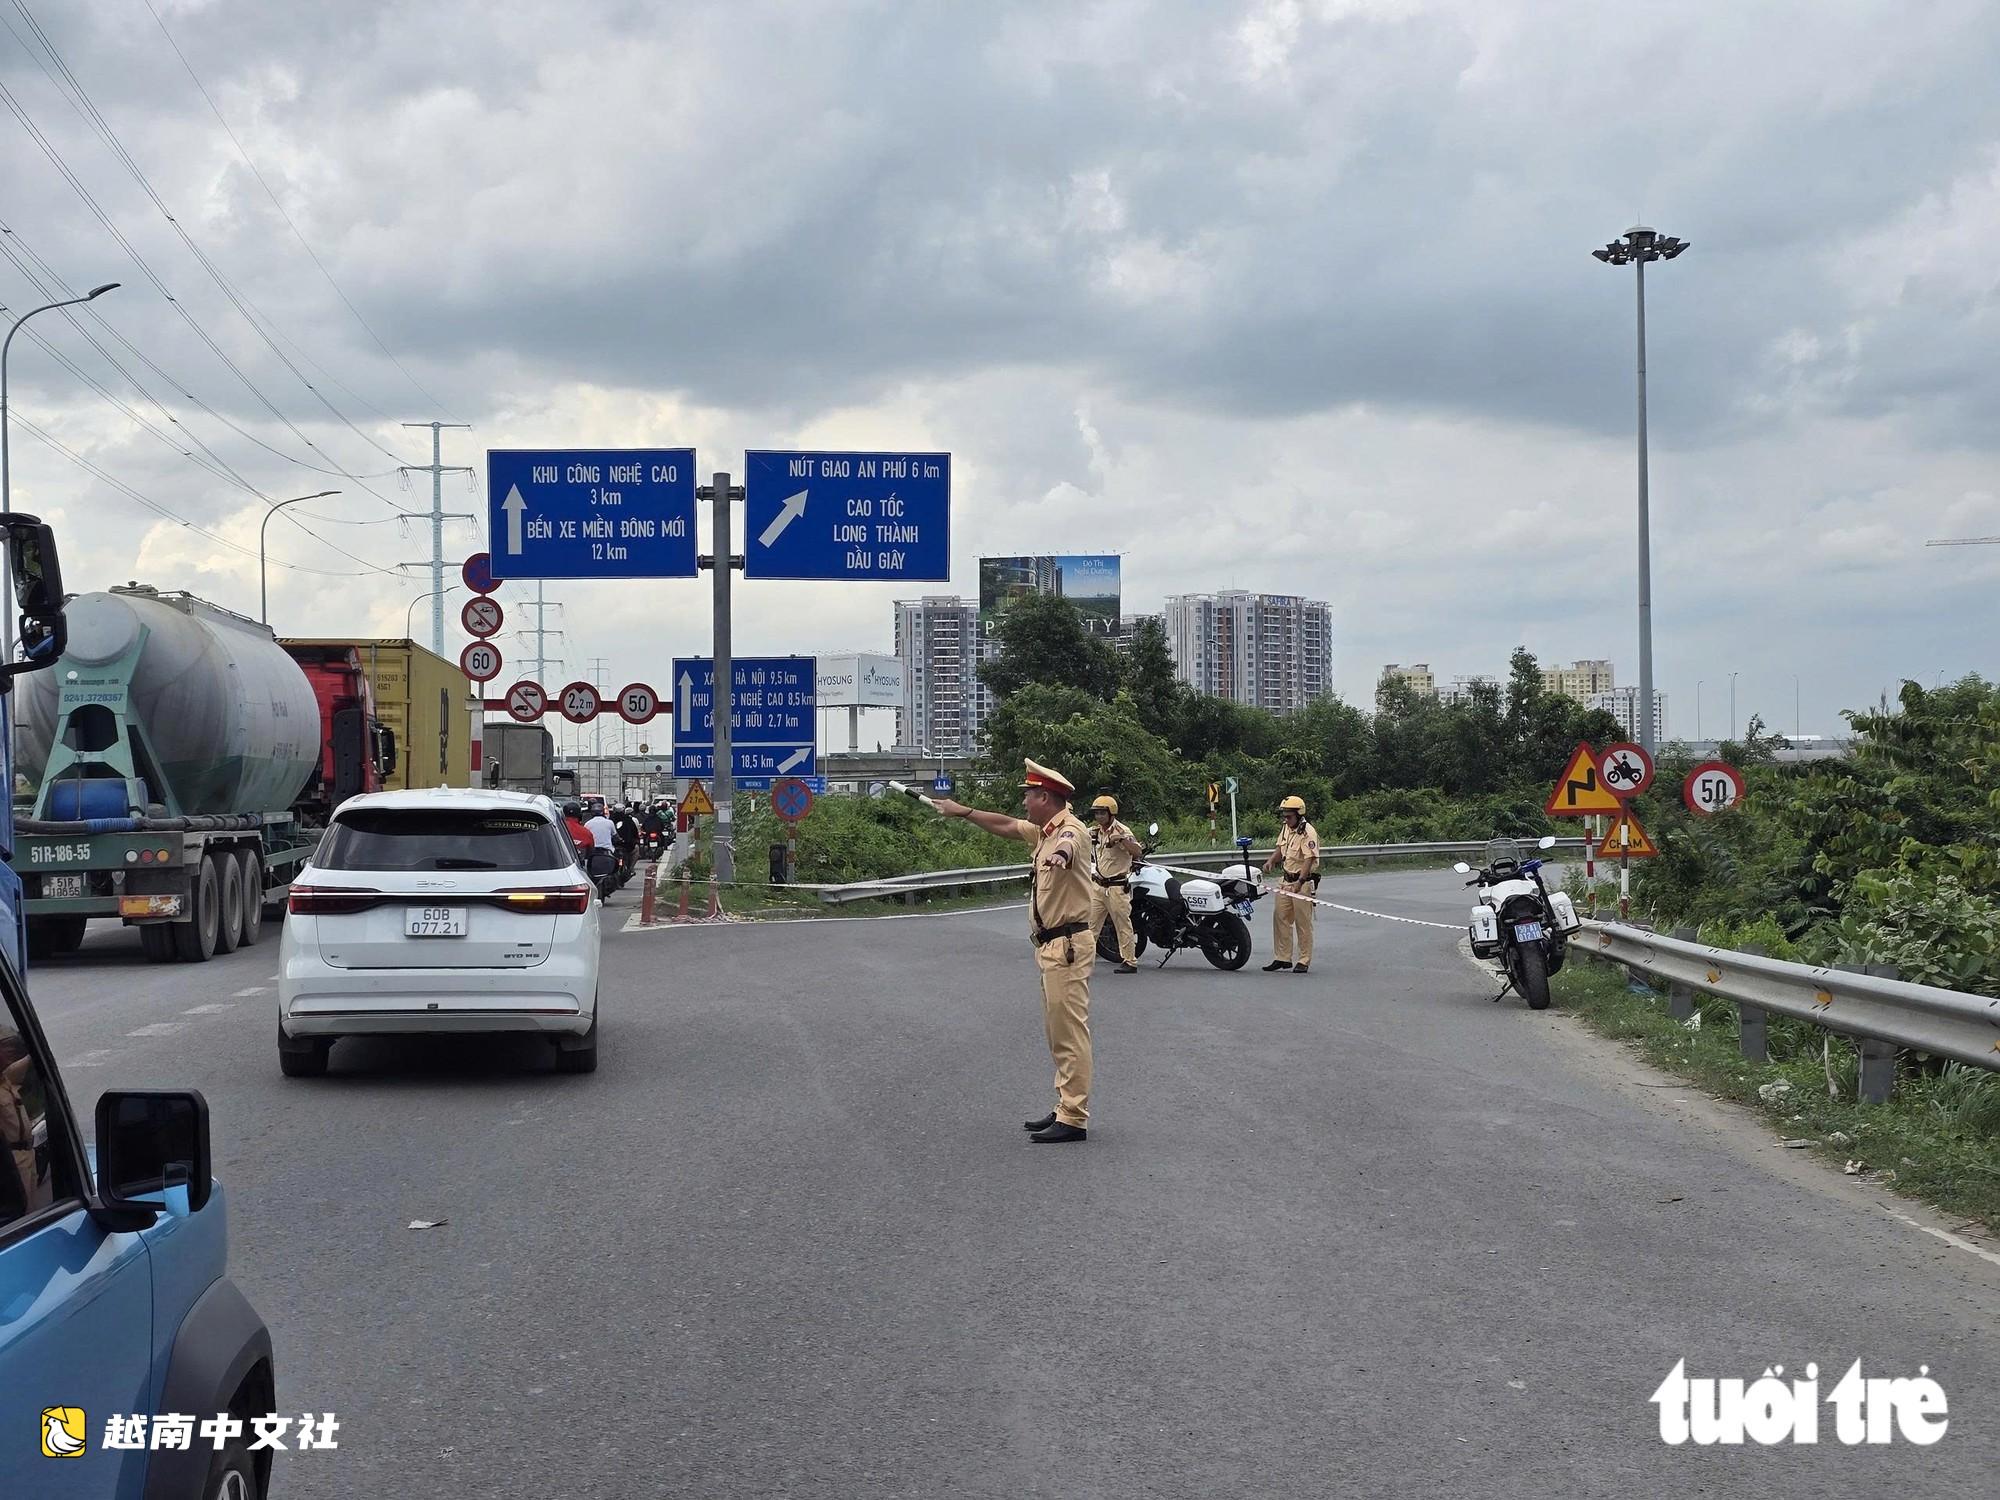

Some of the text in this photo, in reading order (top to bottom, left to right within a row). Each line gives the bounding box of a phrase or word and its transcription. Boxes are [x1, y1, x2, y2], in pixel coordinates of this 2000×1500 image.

[533, 463, 677, 485] KHU CÔNG NGHỆ CAO
[789, 456, 940, 479] NÚT GIAO AN PHÚ 6 km
[590, 488, 622, 505] 3 km
[847, 492, 904, 517] CAO TỐC
[527, 513, 685, 539] BẾN XE MIỀN ĐÔNG MỚI
[834, 521, 919, 543] LONG THÀNH
[592, 543, 627, 560] 12 km
[847, 545, 906, 570] DẦU GIÂY
[472, 652, 490, 669] 60
[735, 668, 747, 685] HÀ
[751, 668, 765, 687] NỘI
[770, 671, 783, 685] 9,5
[785, 671, 797, 685] km
[817, 674, 853, 687] HYOSUNG
[874, 676, 900, 687] HYOSUNG
[628, 695, 647, 712] 50
[692, 694, 709, 707] KHU
[740, 691, 762, 709] NGHỆ
[767, 692, 784, 706] CAO
[788, 692, 800, 707] 8,5
[801, 692, 814, 706] km
[745, 711, 762, 728] HỮU
[768, 714, 782, 728] 2,7
[785, 713, 799, 728] km
[680, 755, 702, 769] LONG
[741, 755, 758, 769] 18,5
[761, 754, 774, 768] km
[1701, 779, 1727, 804] 50
[31, 843, 91, 864] 51R-186-55
[1187, 896, 1208, 905] CSGT
[423, 908, 450, 921] 60B
[1563, 917, 1569, 926] 7
[411, 922, 459, 934] 077.21
[1484, 928, 1490, 939] 7
